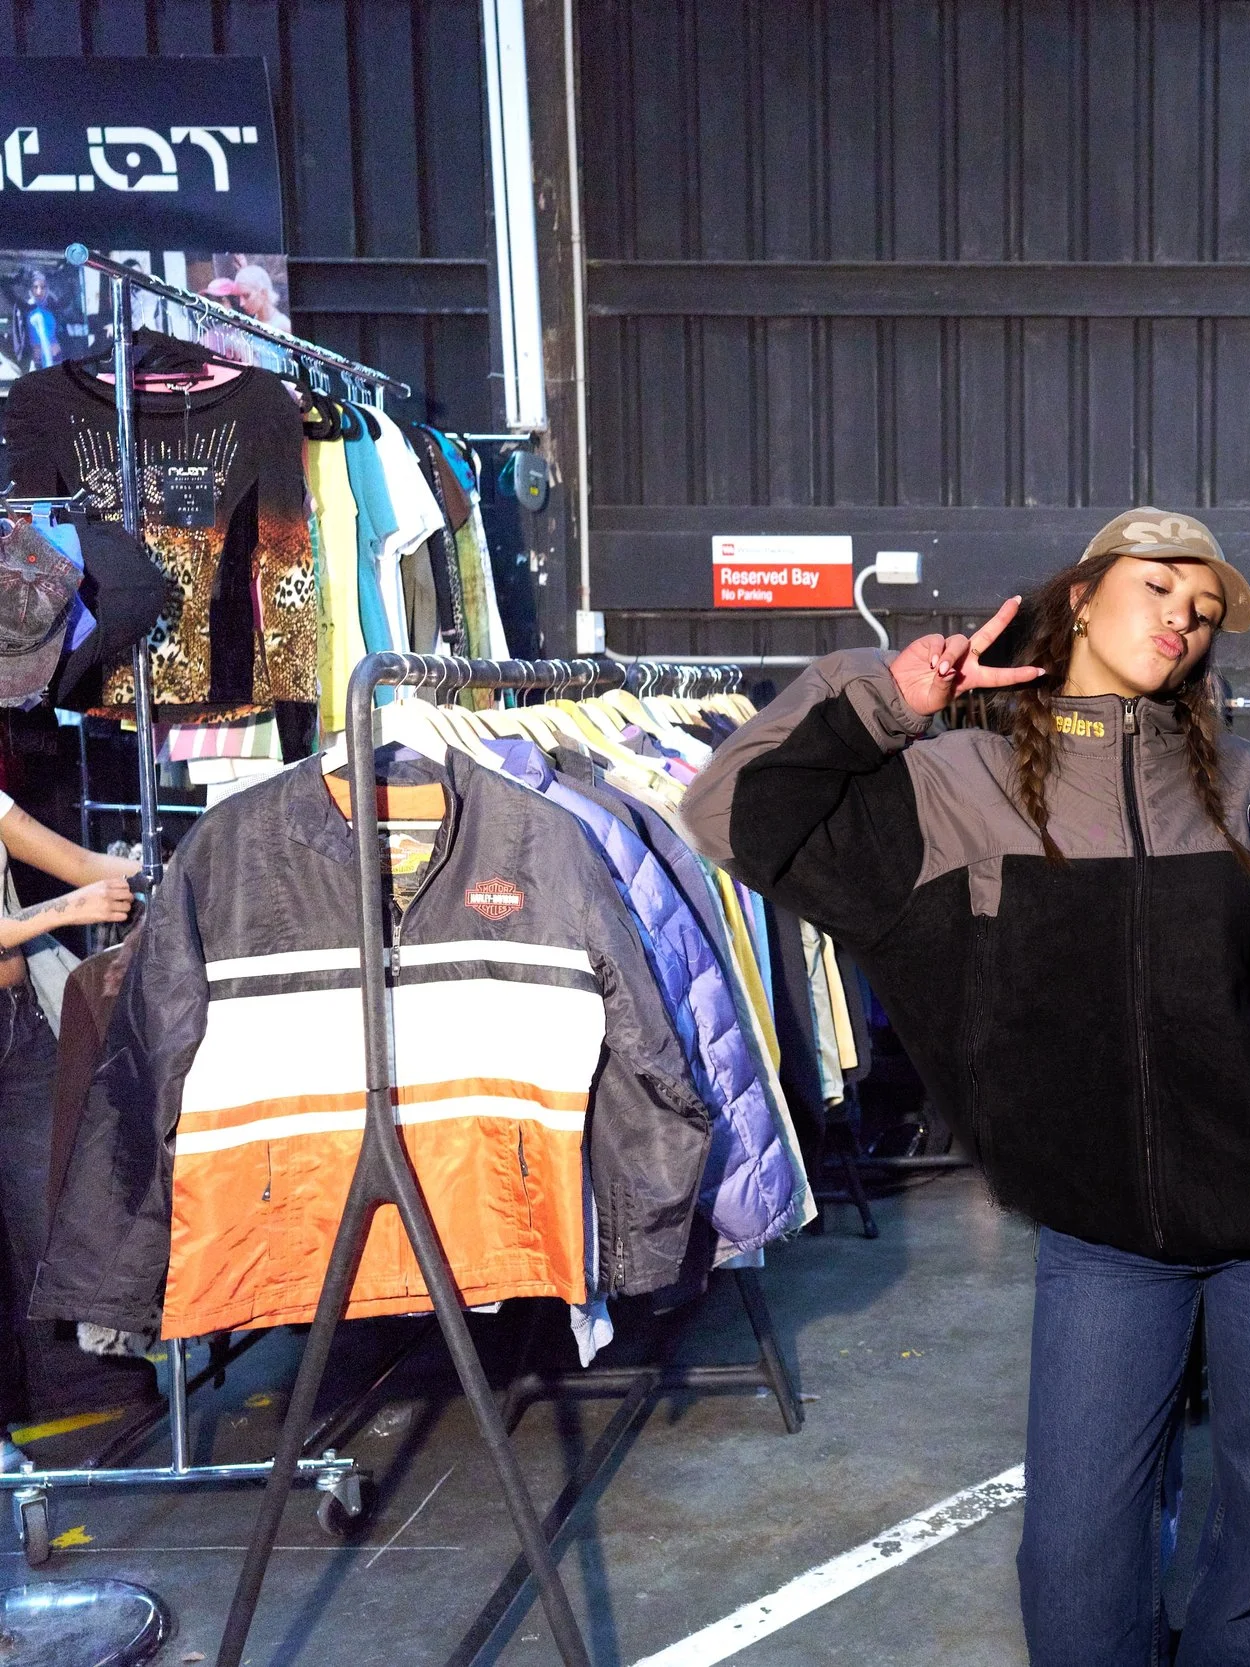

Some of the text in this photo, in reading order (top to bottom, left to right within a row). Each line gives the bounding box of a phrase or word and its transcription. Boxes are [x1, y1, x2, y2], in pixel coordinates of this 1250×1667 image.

[721, 567, 820, 589] Reserved Bay
[721, 588, 773, 603] No Parking
[1054, 711, 1105, 738] eelers
[481, 905, 508, 916] CYCLES
